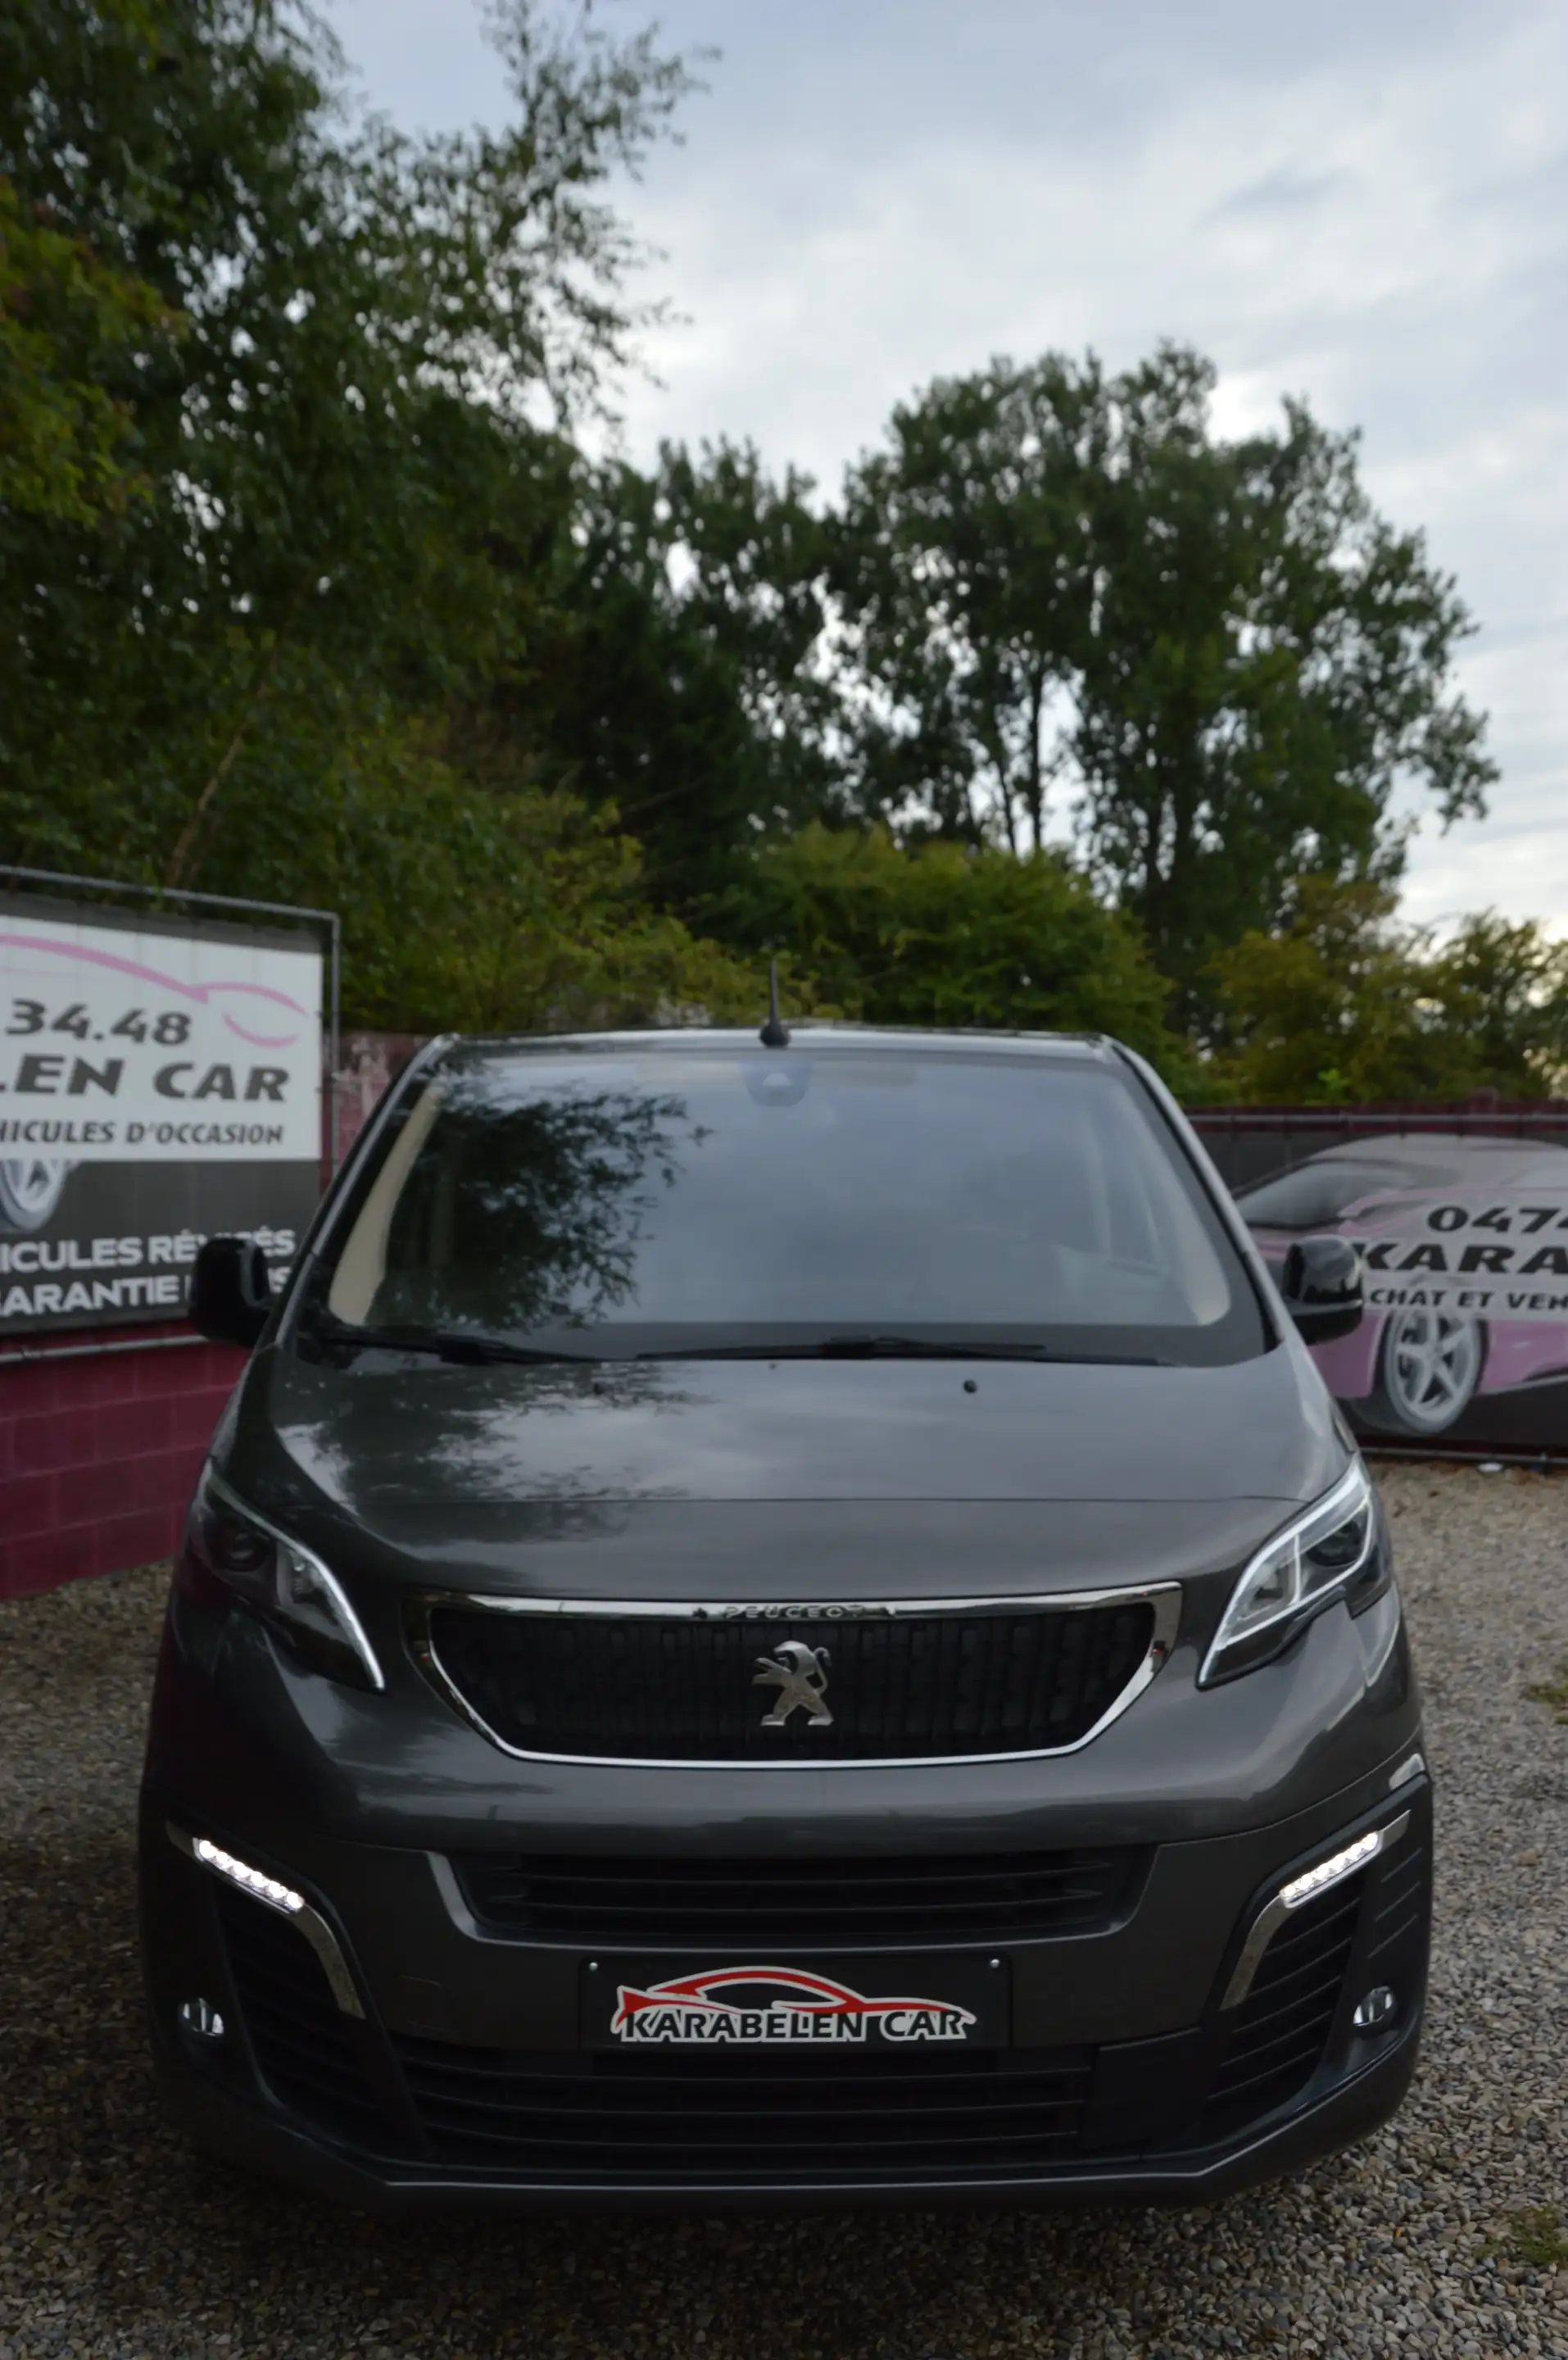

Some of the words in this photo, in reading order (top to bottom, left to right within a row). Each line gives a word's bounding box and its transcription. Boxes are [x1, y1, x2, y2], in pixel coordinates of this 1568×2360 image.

[0, 1053, 125, 1098] EN
[153, 1061, 290, 1101] CAR
[125, 1121, 283, 1145] D'OCCASION
[1427, 1205, 1568, 1234] 047
[1457, 1291, 1494, 1309] ET
[625, 2008, 864, 2040] KARABELEN
[878, 2007, 963, 2039] CAR
